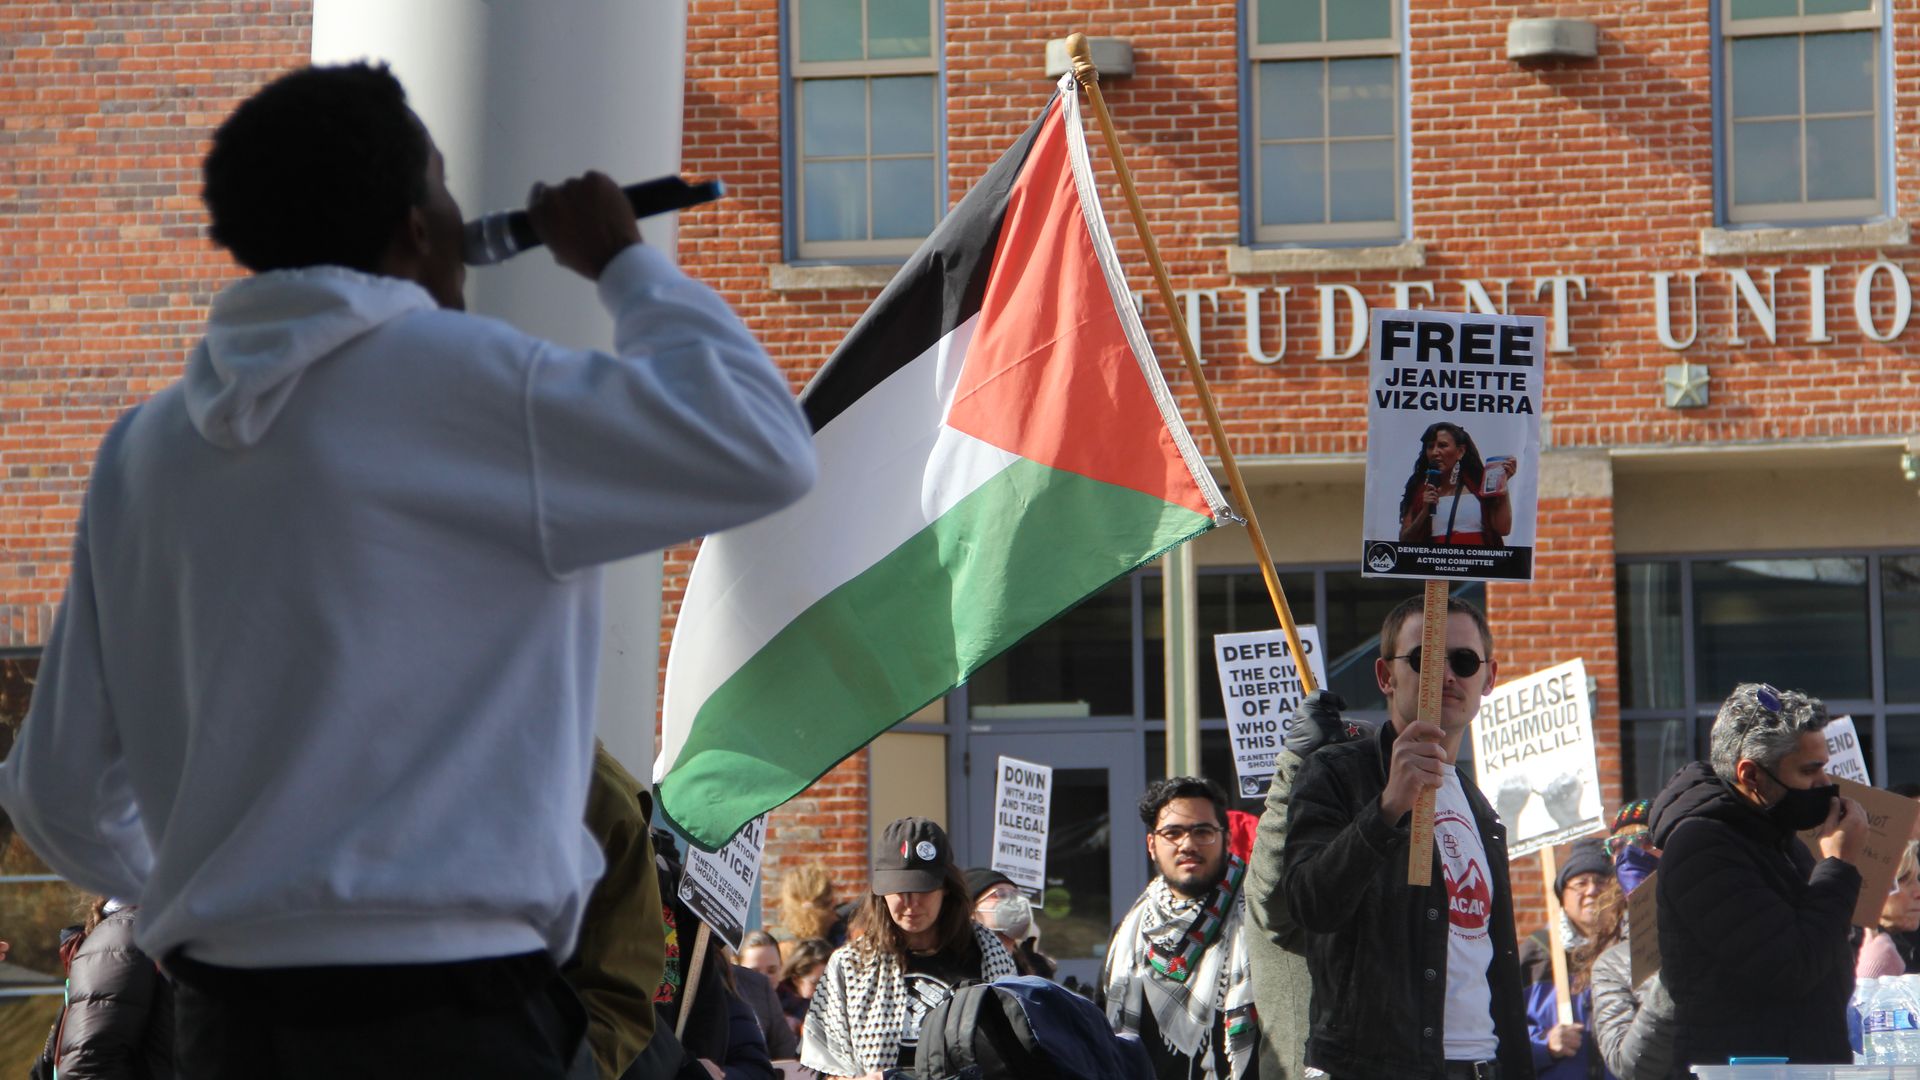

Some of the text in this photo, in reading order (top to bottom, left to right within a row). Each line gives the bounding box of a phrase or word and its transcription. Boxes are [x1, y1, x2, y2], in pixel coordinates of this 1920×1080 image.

[1132, 275, 1587, 365] TUDT
[1380, 320, 1534, 366] FREE
[1385, 368, 1526, 391] JEANETTE
[1375, 389, 1534, 415] VIZGUERRA
[1397, 546, 1514, 557] DENVER-AURORA COMMUNITY
[1416, 556, 1494, 566] ACTION COMMITTEE
[1229, 665, 1297, 682] THE CIV
[1229, 674, 1318, 698] LIBERTI
[1242, 700, 1271, 716] OF
[1479, 671, 1576, 731] RELEASE
[1236, 720, 1276, 735] WHO
[1481, 701, 1579, 756] MAHMOUD
[1236, 735, 1275, 750] THIS
[1484, 725, 1583, 774] KHALIL!
[1247, 758, 1279, 769] SHOUL
[1832, 758, 1860, 776] CIVIL
[1004, 765, 1046, 790] DOWN
[1002, 798, 1045, 815] AND THEIR
[1005, 786, 1044, 804] WITH APD
[999, 811, 1045, 834] ILLEGAL
[999, 842, 1022, 858] WITH
[690, 849, 719, 878] JEANETTE
[719, 873, 748, 909] VIZGUERRA
[694, 863, 717, 888] SHOULD
[718, 885, 725, 897] BE
